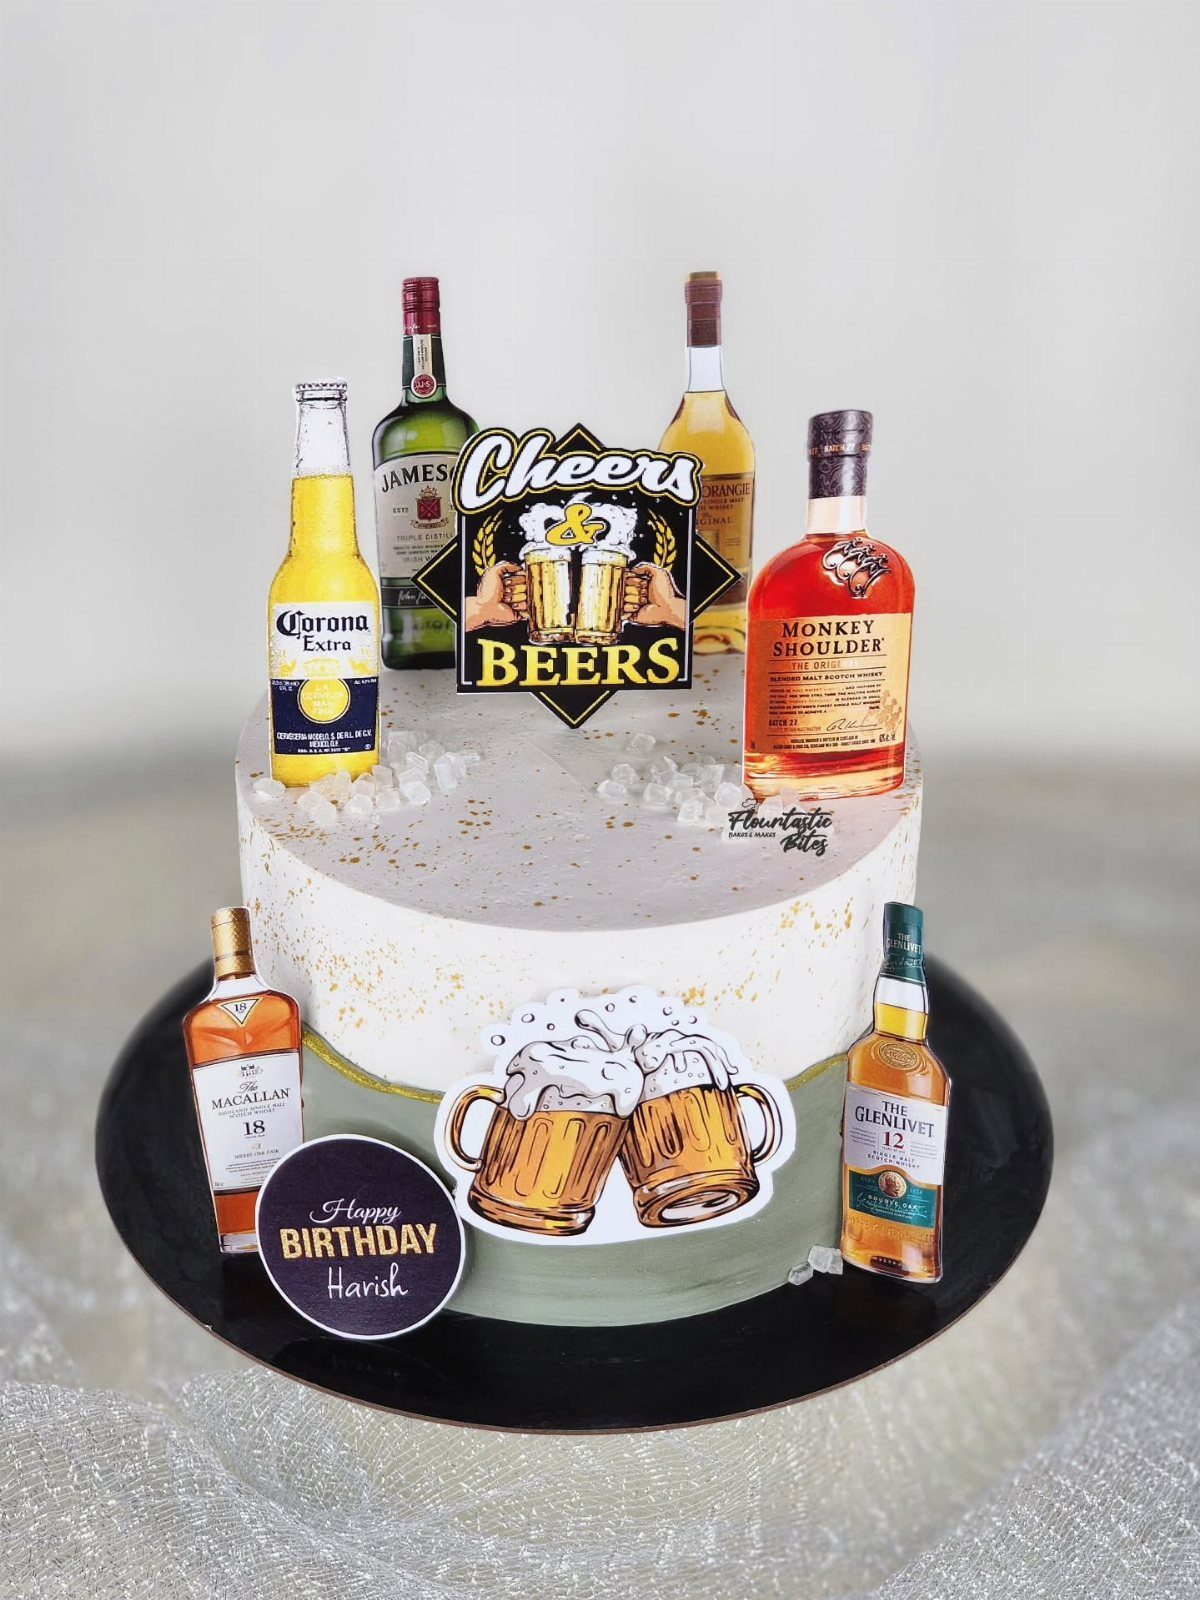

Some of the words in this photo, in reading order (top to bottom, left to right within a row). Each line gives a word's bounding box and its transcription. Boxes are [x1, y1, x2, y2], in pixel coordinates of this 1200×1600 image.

[457, 428, 697, 511] Cheers
[545, 503, 606, 547] &
[276, 609, 369, 640] Corona
[782, 619, 875, 638] MONKEY
[302, 634, 352, 652] Extra
[772, 639, 882, 658] SHOULDER
[475, 637, 682, 687] BEERS
[791, 661, 810, 671] THE
[768, 719, 787, 727] BATCH
[897, 932, 911, 942] THE
[886, 938, 921, 955] GLENLIVET
[234, 1002, 247, 1012] 18
[237, 1080, 259, 1094] The
[211, 1087, 290, 1110] MACALLAN
[882, 1100, 908, 1117] THE
[242, 1119, 266, 1136] 18
[855, 1105, 935, 1138] GLENLIVET
[882, 1131, 905, 1150] 12
[867, 1153, 893, 1164] SCOTCH
[896, 1161, 920, 1169] WHISKY
[873, 1149, 896, 1159] SINGLE
[868, 1194, 900, 1207] DOUBLE
[309, 1197, 401, 1225] Happy
[279, 1222, 437, 1260] BIRTHDAY
[327, 1262, 409, 1299] Harish
